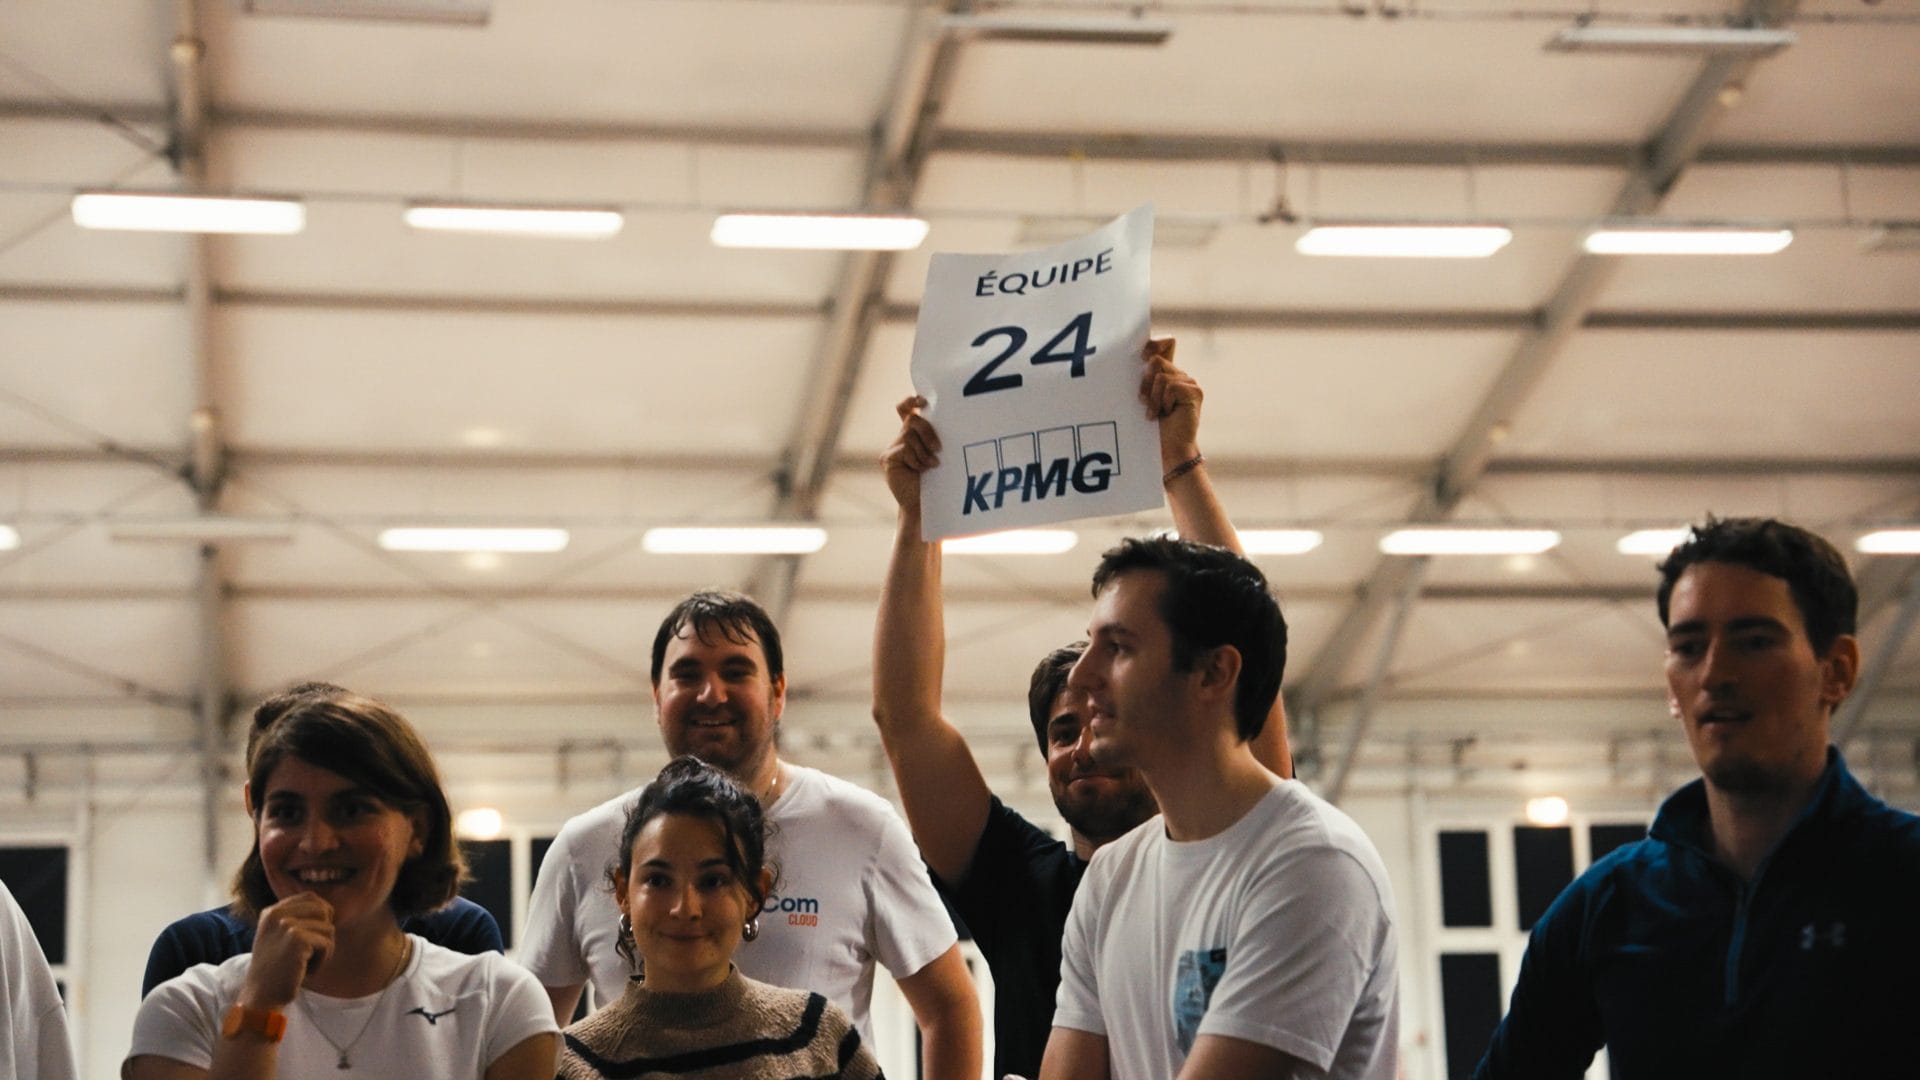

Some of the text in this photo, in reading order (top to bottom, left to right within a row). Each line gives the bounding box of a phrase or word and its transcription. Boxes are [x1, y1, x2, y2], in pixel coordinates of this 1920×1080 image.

[975, 247, 1114, 297] ÉQUIPE
[962, 311, 1097, 397] 24
[962, 452, 1113, 515] KPMG
[788, 913, 818, 927] CLOUD
